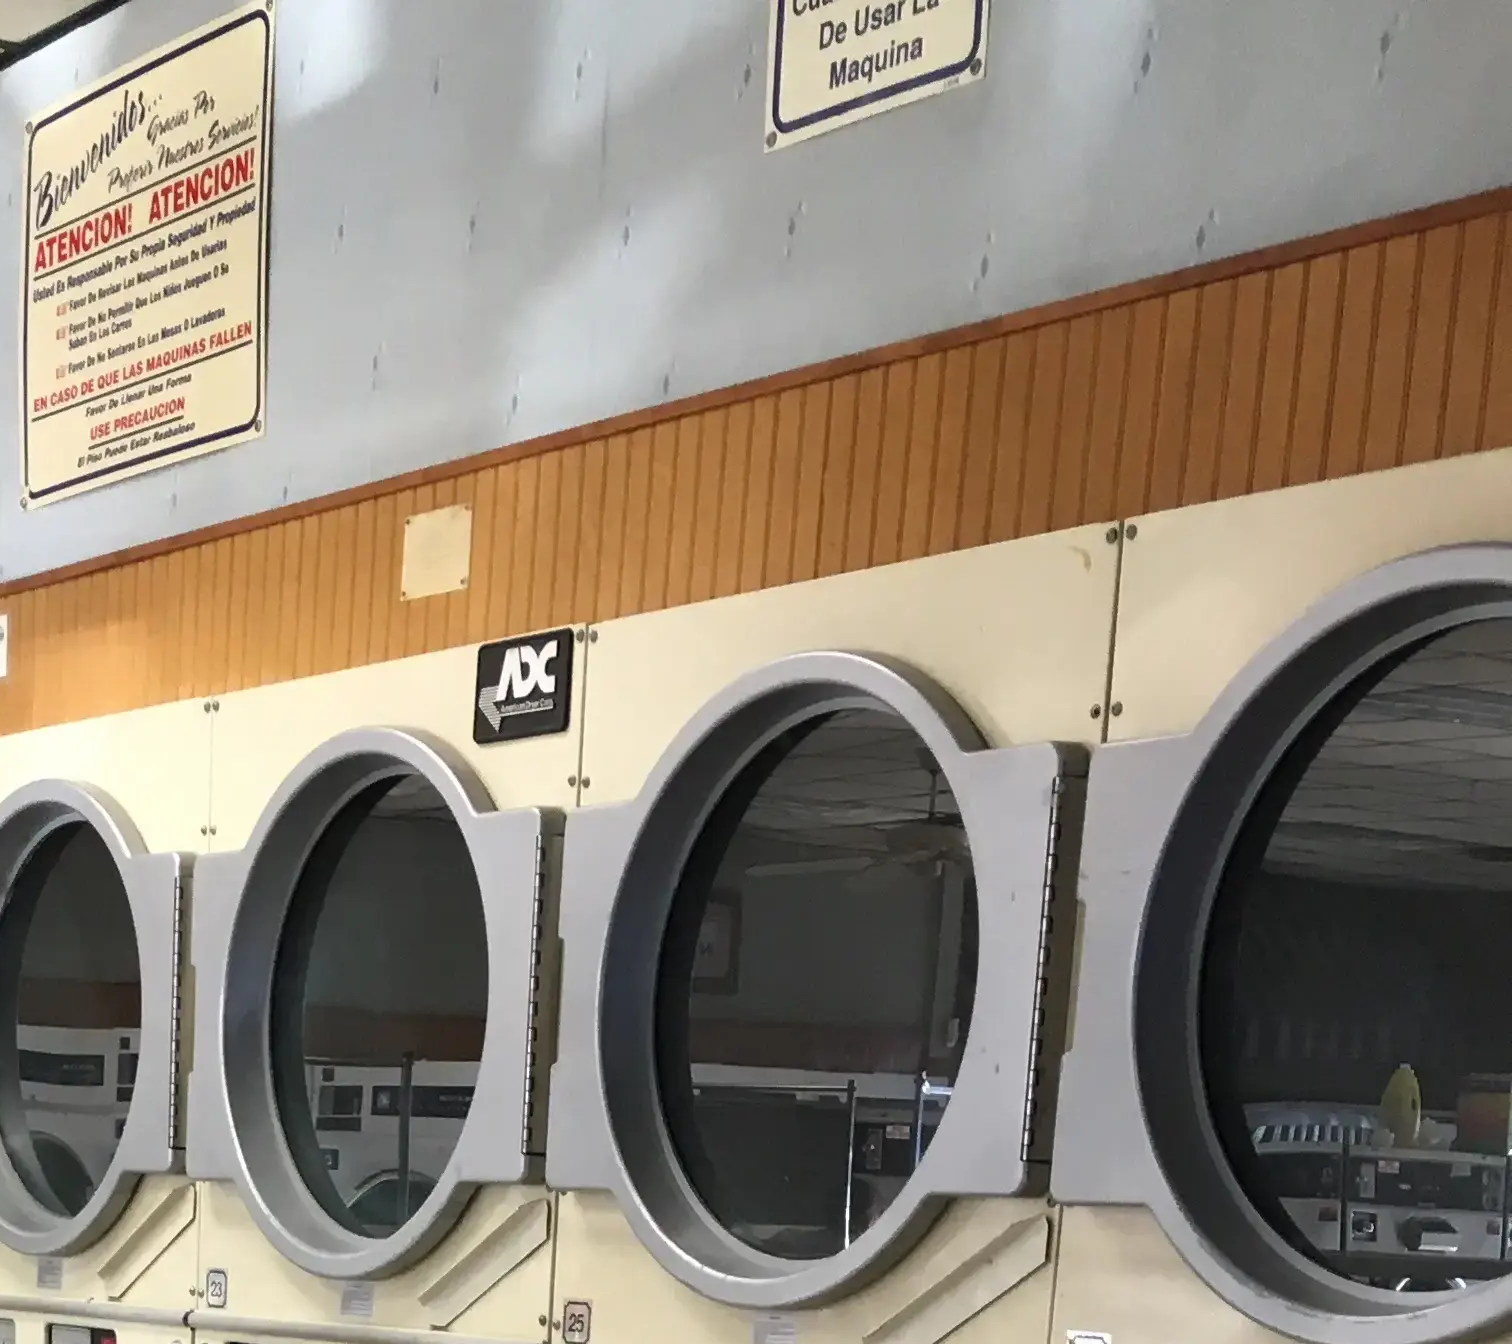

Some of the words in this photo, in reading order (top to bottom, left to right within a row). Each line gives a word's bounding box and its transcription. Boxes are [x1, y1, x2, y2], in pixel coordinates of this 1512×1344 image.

[819, 20, 847, 50] De
[854, 0, 906, 36] Usar
[829, 36, 923, 90] Maquina
[147, 109, 189, 147] Gracias
[193, 90, 215, 119] Por
[35, 203, 133, 272] ATENCION!
[148, 147, 255, 224] ATENCION!
[33, 282, 55, 303] Usted
[168, 218, 207, 248] Seguridad
[33, 395, 48, 412] EN
[50, 384, 78, 407] CASO
[80, 377, 94, 396] DE
[97, 369, 120, 390] QUE
[122, 360, 144, 381] LAS
[146, 337, 206, 372] MAQUINAS
[209, 319, 252, 349] FALLEN
[90, 420, 111, 441] USE
[113, 396, 185, 432] PRECAUCION
[495, 640, 558, 702] ADC
[210, 1280, 222, 1297] 23
[568, 1313, 585, 1332] 25
